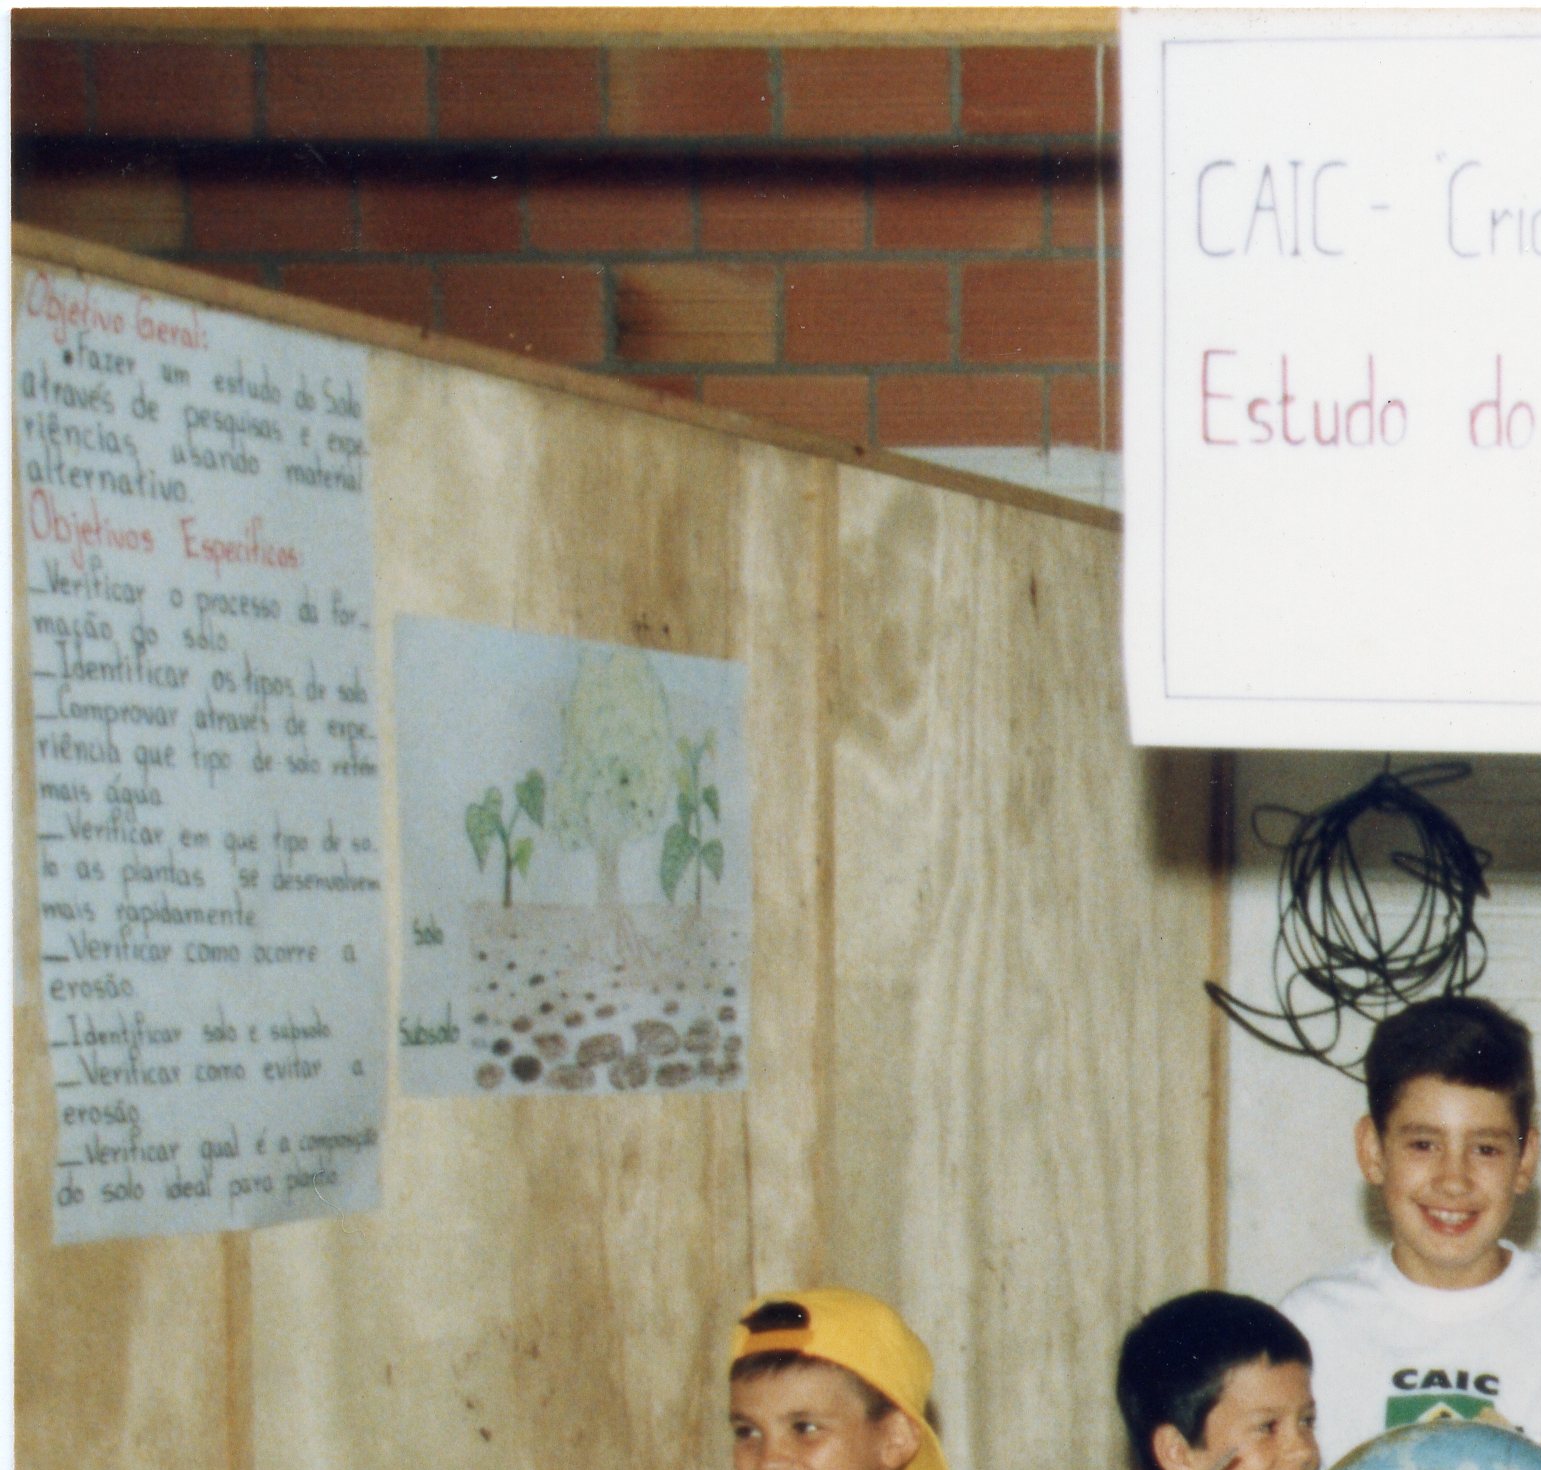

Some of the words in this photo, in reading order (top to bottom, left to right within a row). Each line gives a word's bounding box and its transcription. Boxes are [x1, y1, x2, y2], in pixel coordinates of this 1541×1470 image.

[27, 272, 124, 345] Objetivo
[22, 360, 115, 414] através
[132, 380, 159, 422] de
[184, 405, 282, 449] pesquisas
[161, 364, 191, 385] um
[213, 360, 281, 404] estudo
[295, 374, 316, 412] do
[1201, 350, 1407, 448] Estudo
[1468, 354, 1535, 449] do
[24, 411, 138, 456] riências
[172, 440, 260, 475] usando
[285, 449, 362, 492] material
[29, 488, 155, 570] Objetivos
[33, 610, 113, 645] mação
[132, 608, 158, 645] do
[183, 616, 228, 650] solo
[169, 588, 183, 608] o
[196, 592, 280, 634] processo
[212, 670, 236, 694] os
[243, 652, 295, 713] tipos
[306, 661, 327, 702] de
[195, 692, 269, 733] através
[285, 706, 306, 736] de
[38, 731, 121, 765] riência
[134, 744, 175, 788] que
[190, 728, 230, 788] tipo
[252, 740, 272, 773] de
[40, 782, 91, 802] mais
[180, 828, 209, 847] em
[224, 831, 257, 867] que
[274, 814, 308, 867] tipo
[323, 818, 341, 851] de
[76, 861, 104, 881] as
[121, 849, 205, 899] plantas
[238, 867, 259, 888] se
[42, 902, 95, 922] mais
[116, 888, 256, 937] rapidamente
[186, 942, 240, 963] como
[254, 944, 318, 964] ocorre
[342, 943, 356, 963] a
[50, 973, 134, 1001] erosão
[203, 1005, 237, 1043] solo
[195, 1062, 246, 1083] como
[262, 1052, 321, 1080] evitar
[352, 1059, 364, 1077] a
[63, 1100, 139, 1126] erosão
[201, 1123, 239, 1178] qual
[278, 1137, 290, 1153] a
[57, 1170, 84, 1207] do
[102, 1167, 144, 1203] solo
[166, 1164, 211, 1200] ideal
[229, 1175, 273, 1213] para
[1392, 1368, 1500, 1396] CAIC
